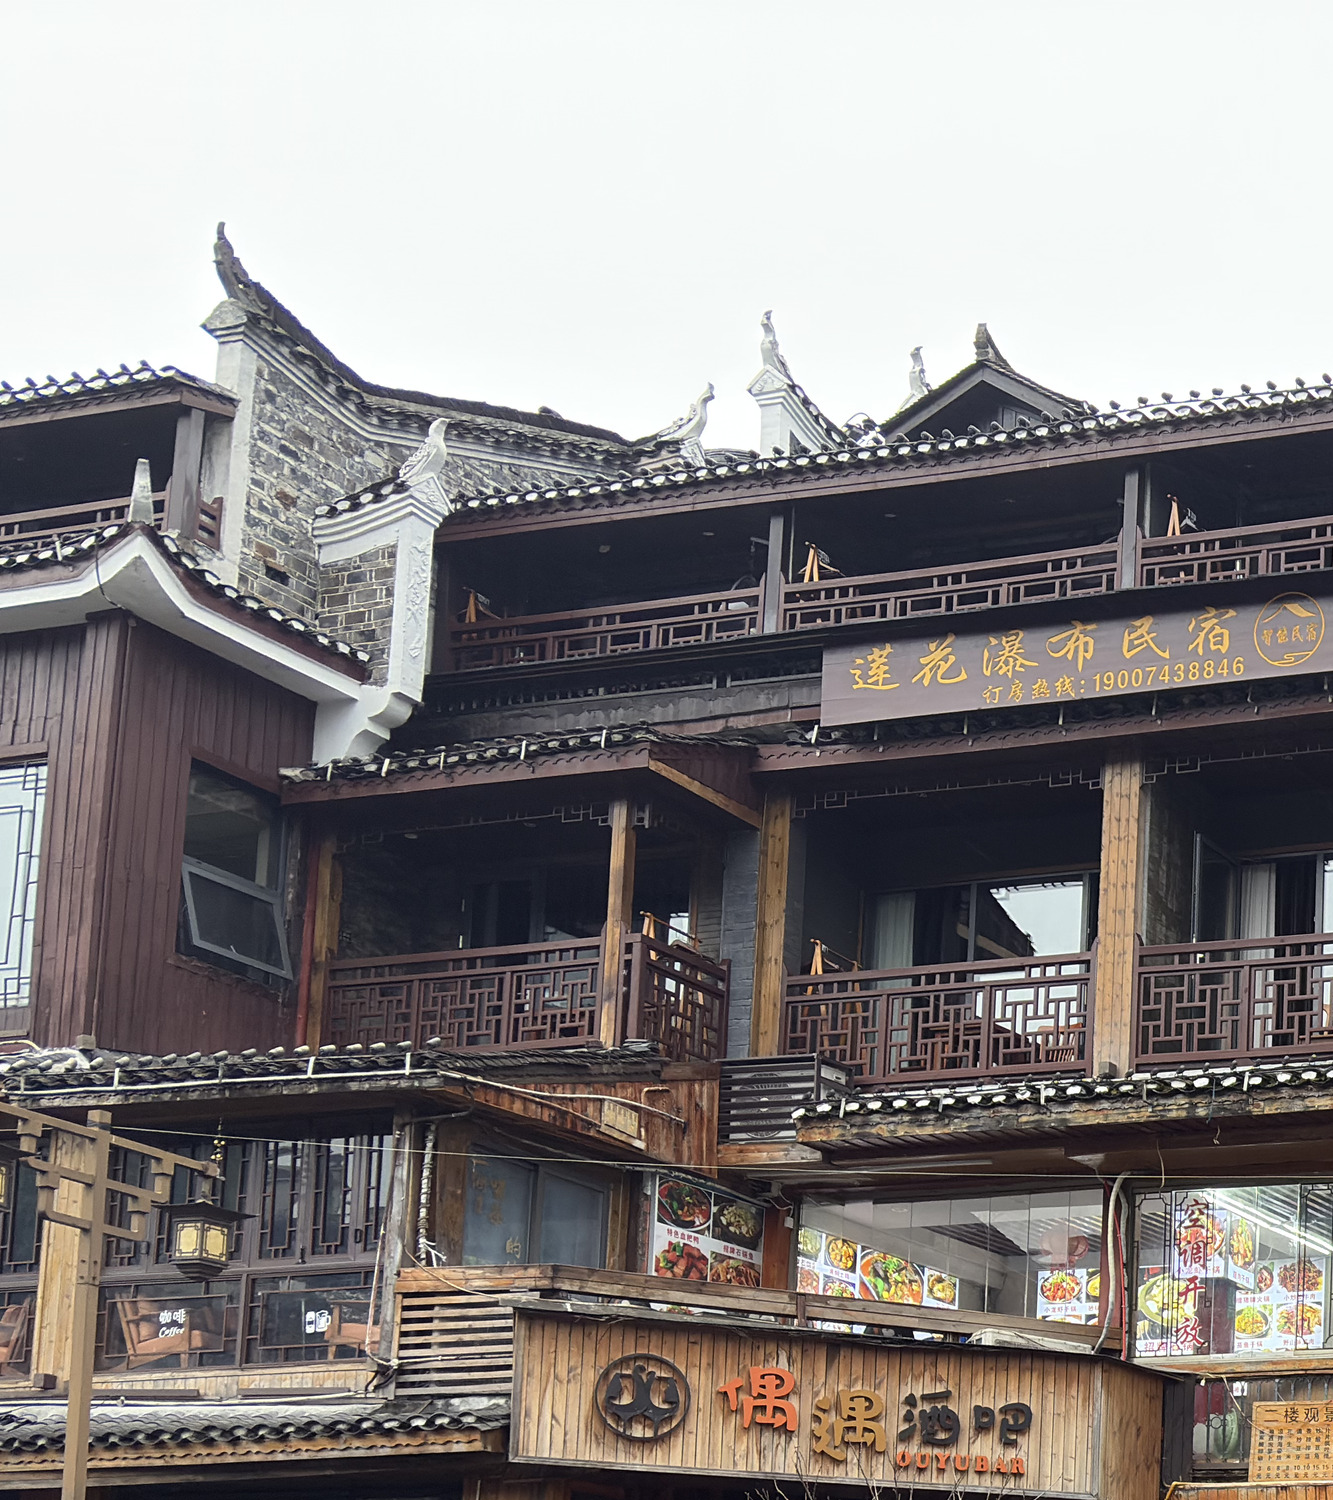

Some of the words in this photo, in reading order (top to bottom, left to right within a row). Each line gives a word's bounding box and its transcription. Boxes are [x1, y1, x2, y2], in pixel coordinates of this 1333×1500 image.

[1261, 622, 1319, 646] 智能民宿
[1174, 1198, 1210, 1346] 空调开放
[159, 1309, 187, 1324] 咖啡
[159, 1326, 185, 1338] Coffee
[718, 1367, 1033, 1461] 偶遇酒吧
[897, 1450, 1025, 1475] OUYUBAR
